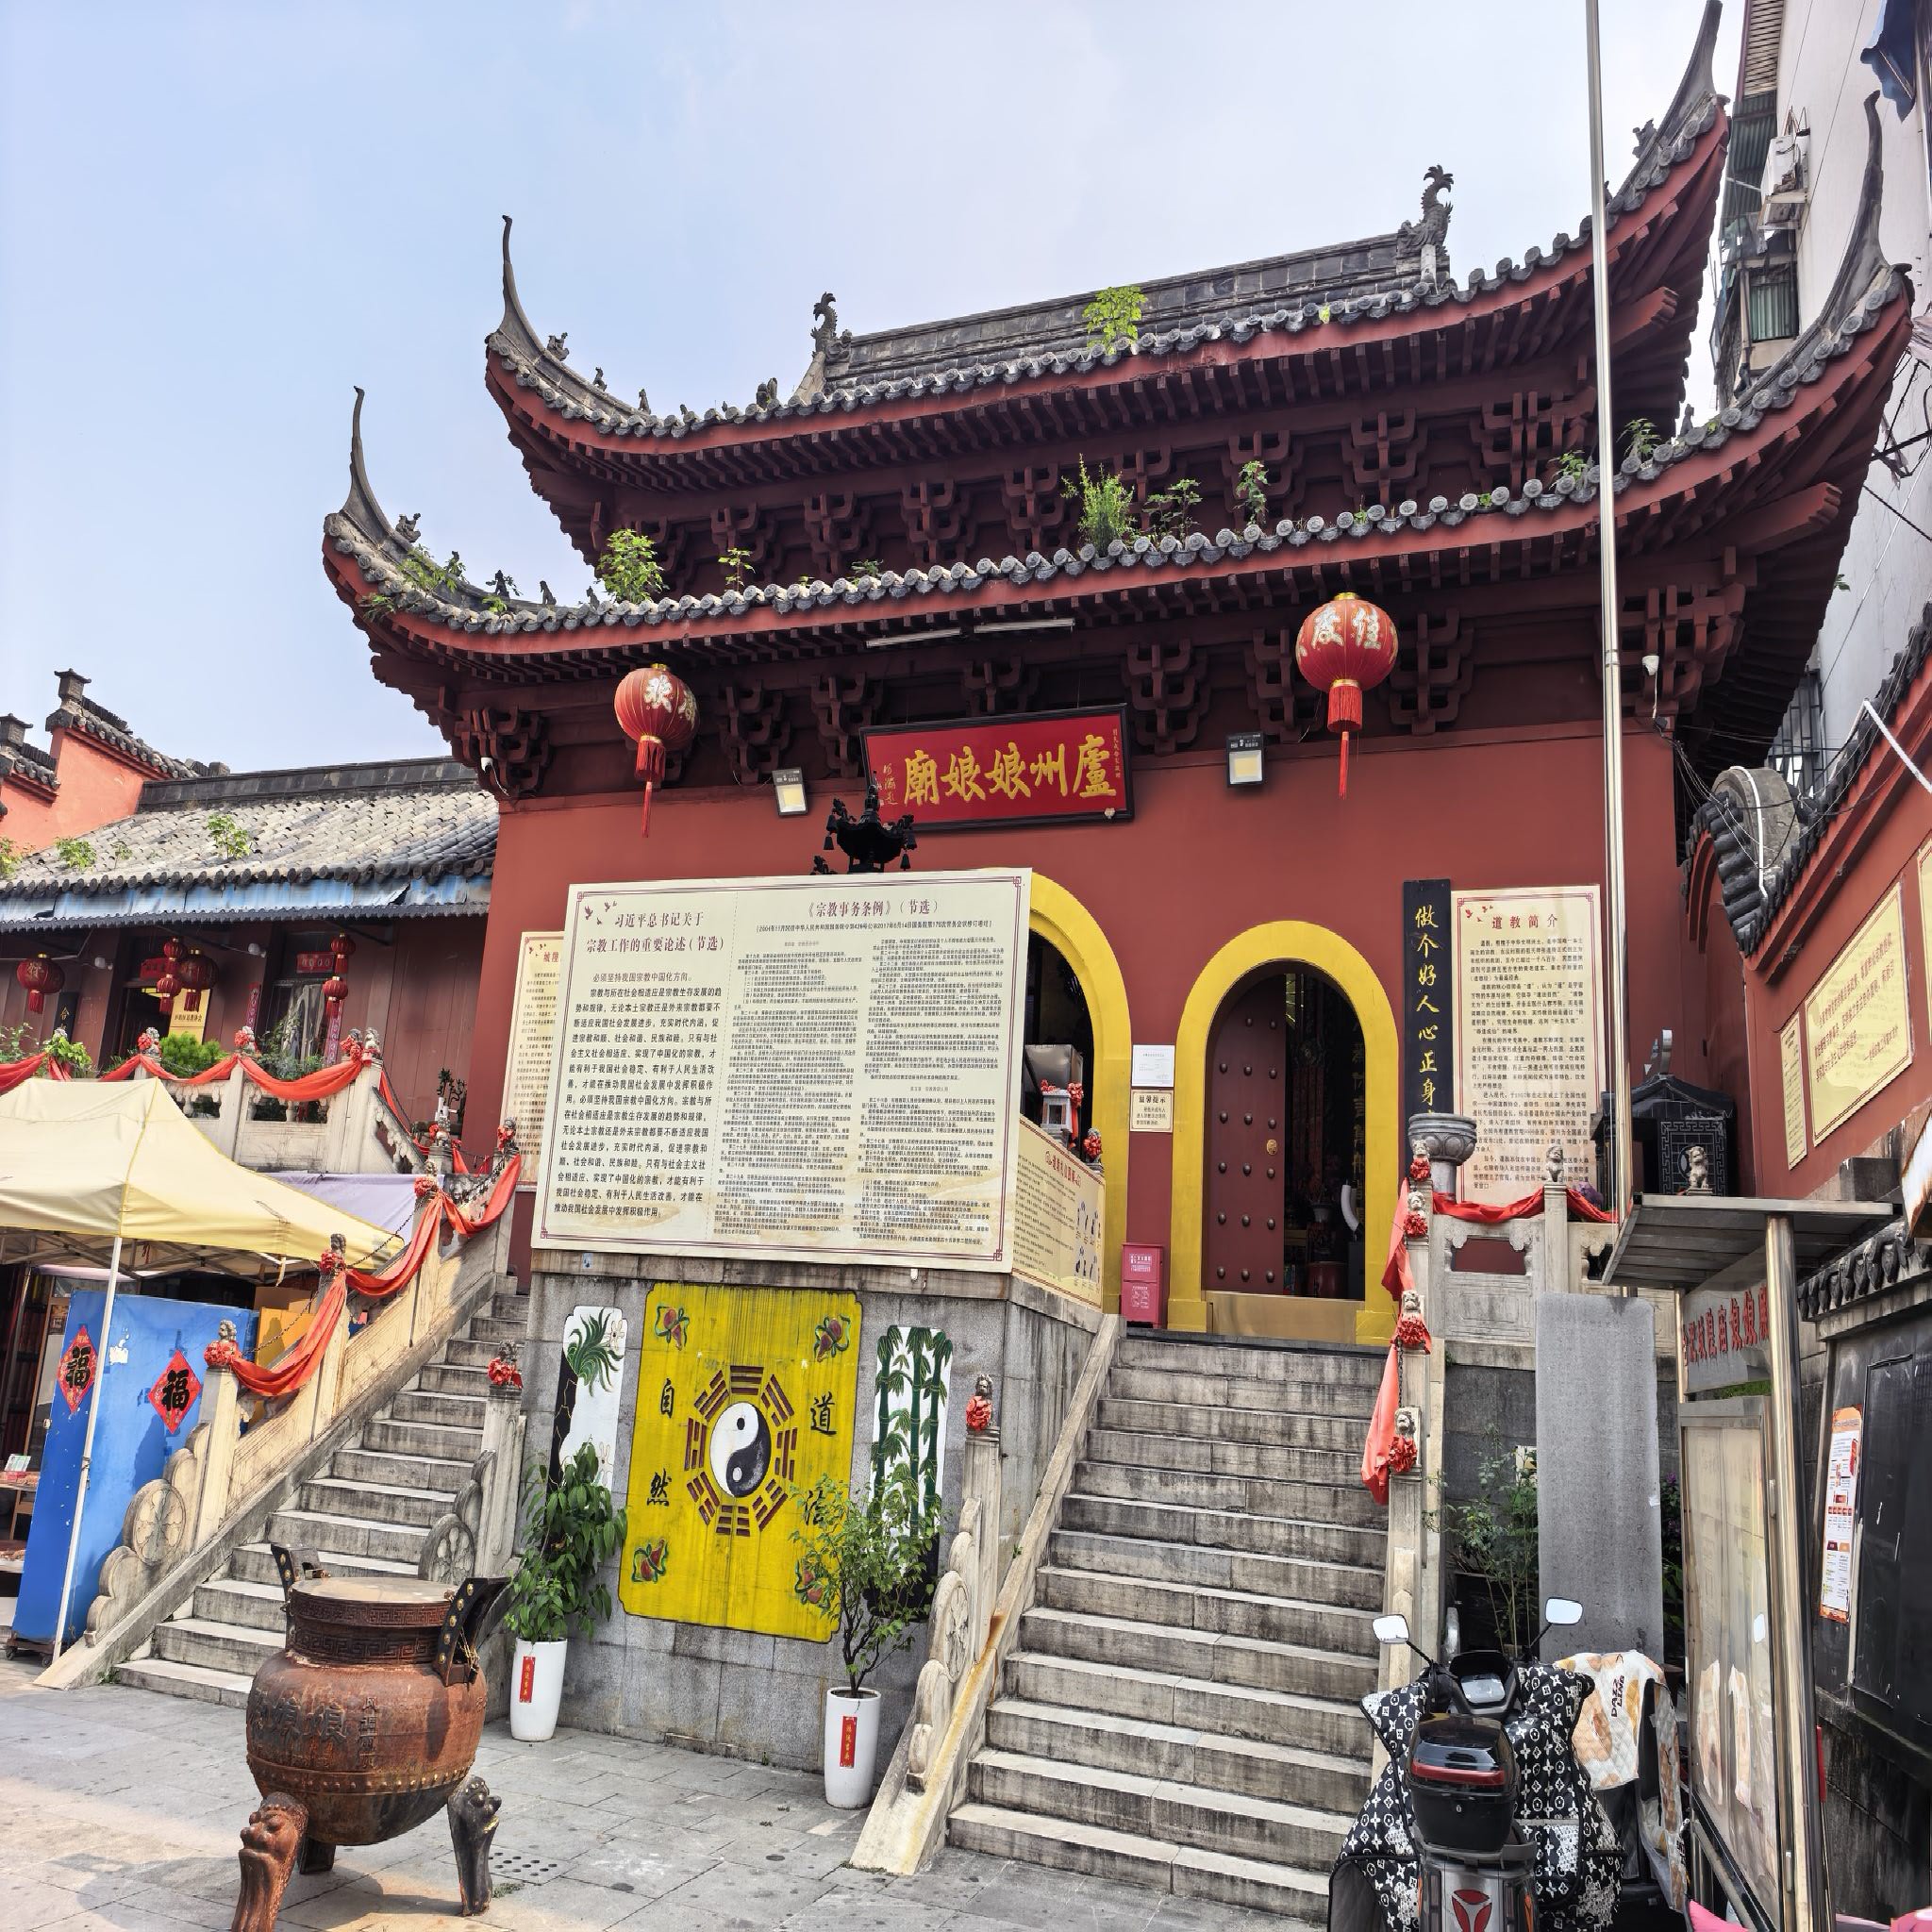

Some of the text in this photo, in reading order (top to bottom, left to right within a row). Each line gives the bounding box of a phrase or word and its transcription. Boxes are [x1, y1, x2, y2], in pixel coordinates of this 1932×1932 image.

[614, 911, 705, 928] 习近平总书记关于
[1491, 913, 1558, 929] 道教简介
[586, 936, 724, 953] 宗教工作的重要论述（节选）
[543, 951, 562, 963] 城隍
[1415, 905, 1441, 1113] 做个好人心正身
[65, 1346, 92, 1390] 福
[162, 1369, 191, 1410] 福
